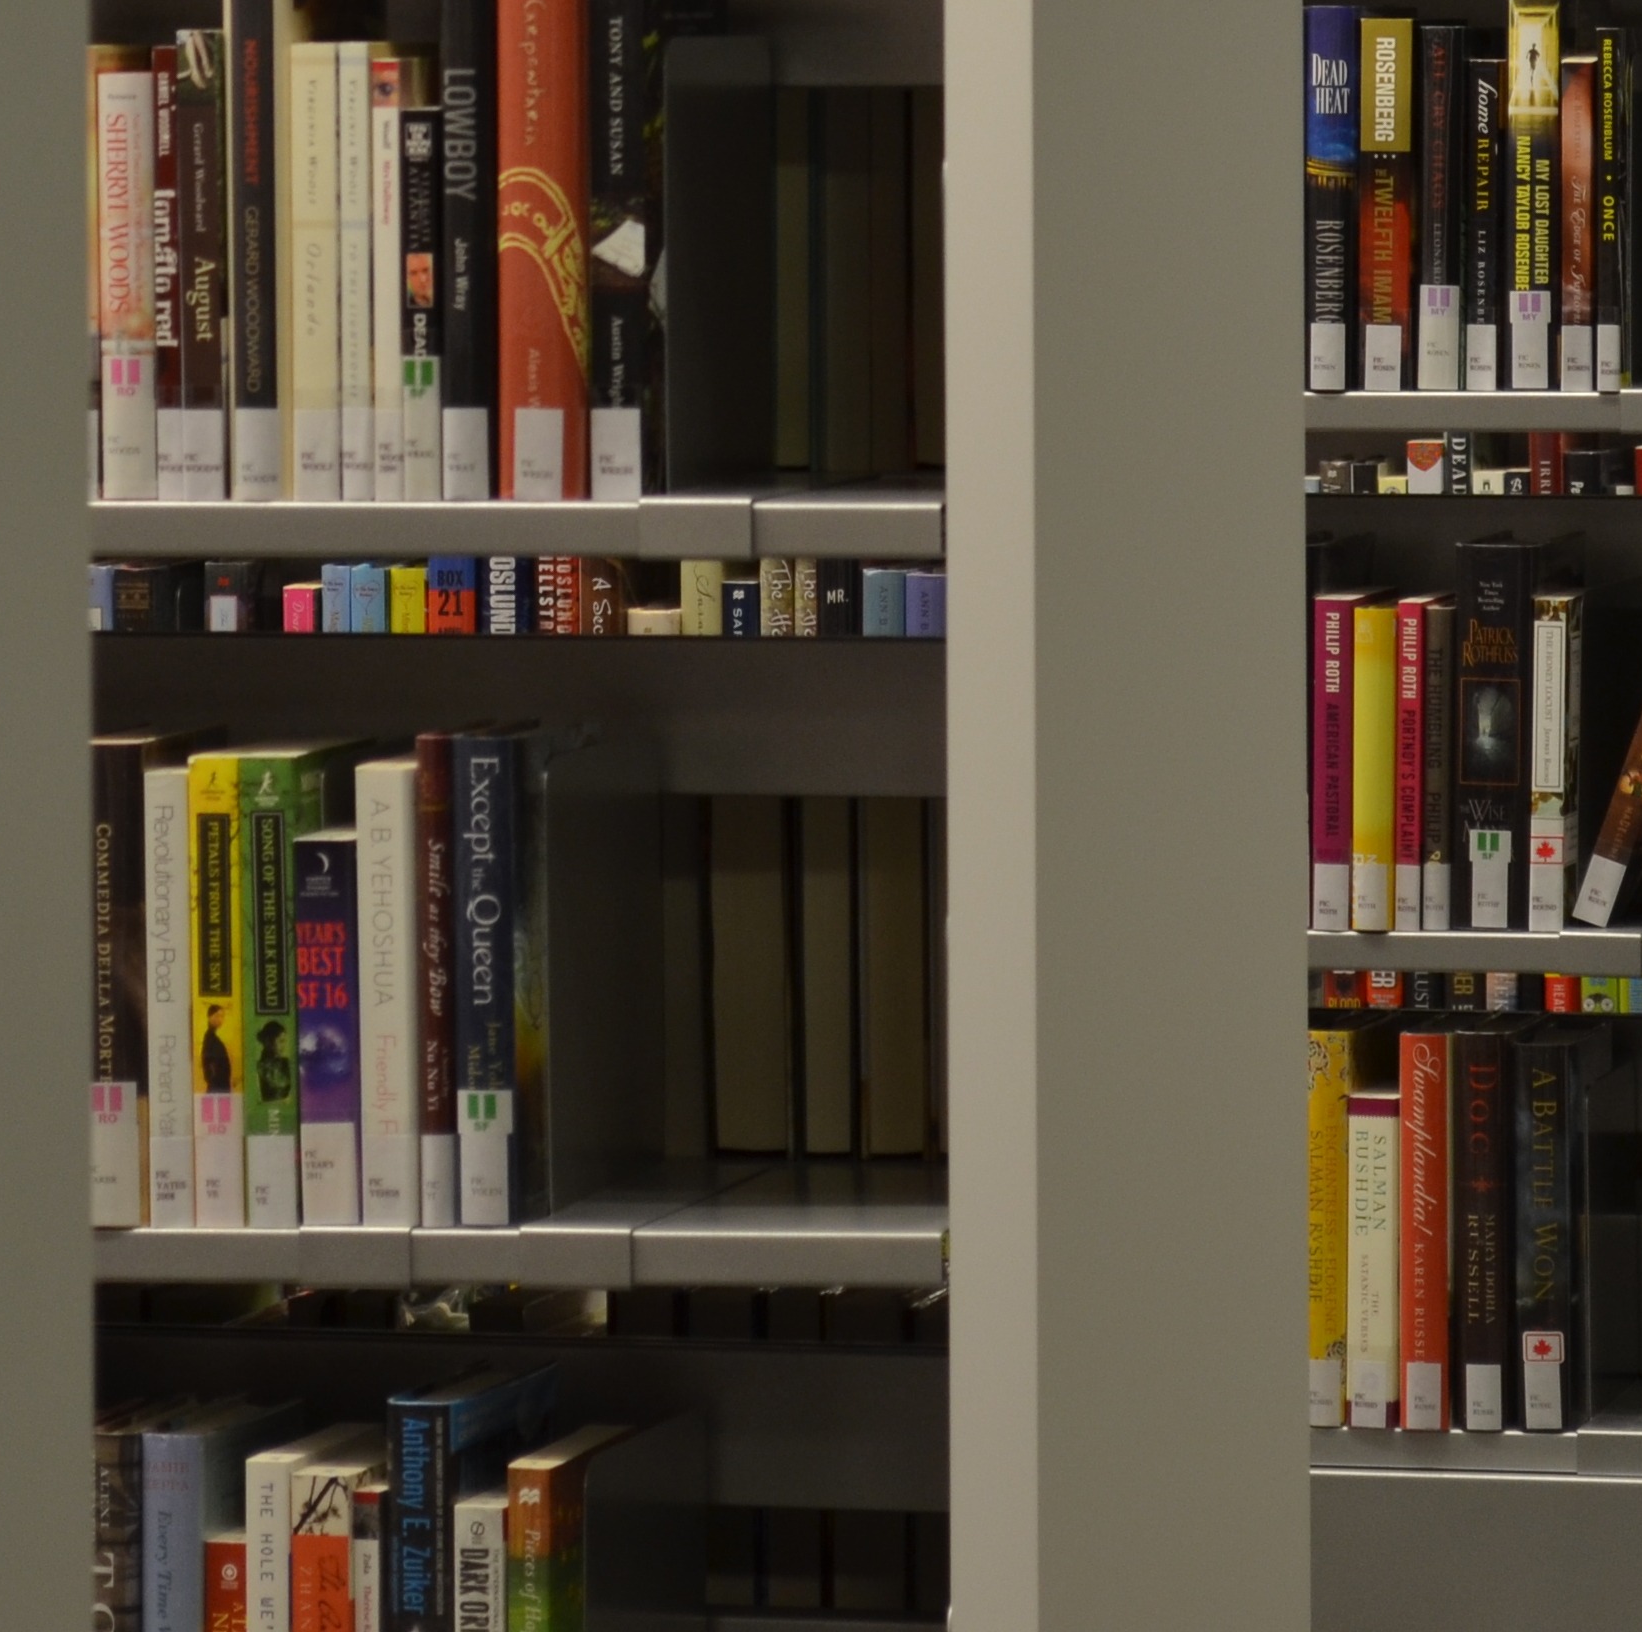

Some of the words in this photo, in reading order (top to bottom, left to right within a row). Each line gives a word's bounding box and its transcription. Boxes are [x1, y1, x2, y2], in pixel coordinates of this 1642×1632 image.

[609, 17, 623, 65] TONY
[1603, 38, 1613, 87] REBECCA
[1312, 53, 1348, 87] DEAD
[1374, 36, 1396, 142] ROSENBERG
[1315, 87, 1351, 114] HEAT
[1477, 78, 1498, 135] home
[443, 68, 477, 201] LOWBOY
[609, 117, 624, 175] SUSAN
[1603, 89, 1613, 161] ROSENBLUM
[106, 113, 127, 212] SHERRYL
[1476, 138, 1489, 212] REPAIR
[1516, 135, 1531, 178] NANCY
[1535, 159, 1550, 183] MY
[1373, 175, 1394, 263] TWELFTH
[1516, 180, 1530, 231] TAYLOR
[1534, 186, 1550, 221] LOST
[1602, 195, 1615, 243] ONCE
[108, 223, 130, 313] WOODS
[1534, 223, 1549, 285] DAUGHTER
[186, 256, 216, 342] August
[1372, 272, 1393, 326] IMAM
[437, 570, 463, 585] BOX
[827, 589, 849, 605] MR.
[438, 590, 463, 616] 21
[1325, 612, 1340, 655] PHILIP
[1403, 618, 1417, 662] PHILIP
[1469, 619, 1515, 646] PATRICK
[1325, 656, 1340, 693] ROTH
[1402, 666, 1416, 699] ROTH
[464, 756, 499, 862] Except
[1429, 792, 1441, 844] PHILIP
[209, 821, 221, 878] PETALS
[261, 818, 275, 863] SONG
[96, 823, 112, 936] COMMEDIA
[150, 805, 174, 942] Revolutionary
[262, 866, 276, 885] OF
[209, 882, 221, 923] FROM
[262, 891, 276, 921] THE
[209, 927, 221, 963] THE
[263, 925, 277, 959] SILK
[371, 856, 393, 1007] YEHOSHUA
[466, 894, 500, 1006] Queen
[97, 941, 112, 1008] DELLA
[156, 948, 175, 1003] Road
[209, 966, 221, 992] SKY
[264, 961, 277, 1007] ROAD
[296, 947, 345, 975] BEST
[297, 981, 320, 1009] SF
[324, 982, 348, 1009] 16
[1469, 1064, 1496, 1155] DOC
[1532, 1101, 1557, 1209] BATTLE
[1373, 1134, 1388, 1232] SALMAN
[1414, 1243, 1425, 1299] KAREN
[1533, 1222, 1558, 1301] WON
[396, 1415, 431, 1510] Anthony
[260, 1482, 274, 1517] THE
[403, 1517, 430, 1536] E.
[260, 1533, 274, 1581] HOLE
[459, 1547, 489, 1595] DARK
